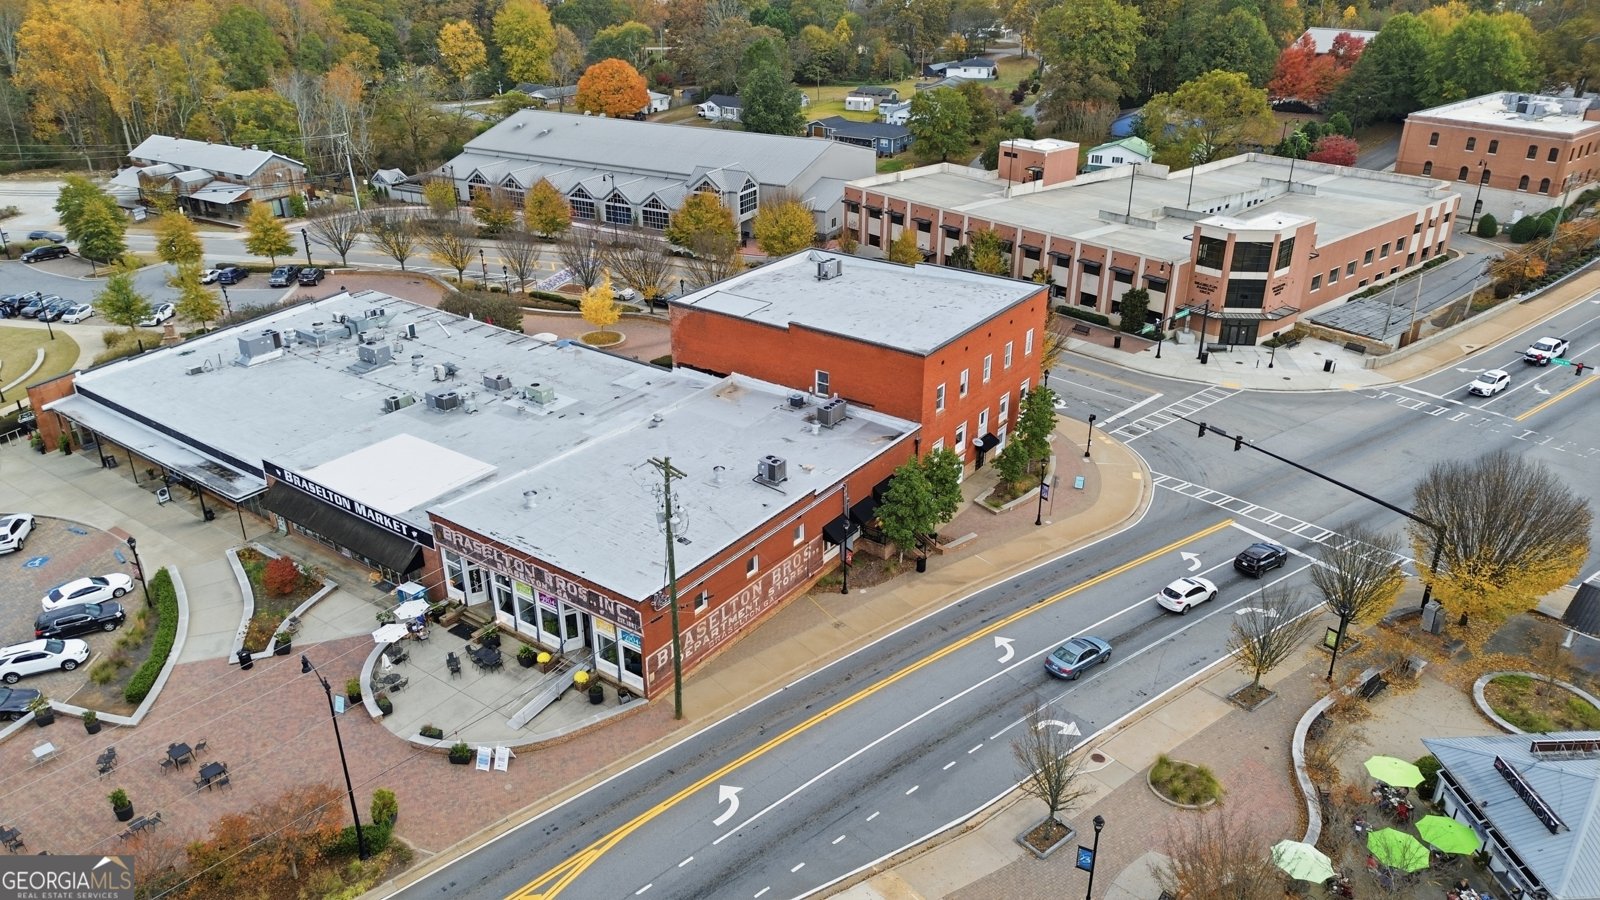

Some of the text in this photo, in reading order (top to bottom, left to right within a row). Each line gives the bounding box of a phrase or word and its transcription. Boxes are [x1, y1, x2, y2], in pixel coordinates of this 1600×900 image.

[284, 470, 408, 536] BRASELTON MARKET
[443, 528, 535, 578] BRASELTON
[599, 595, 632, 620] INC.
